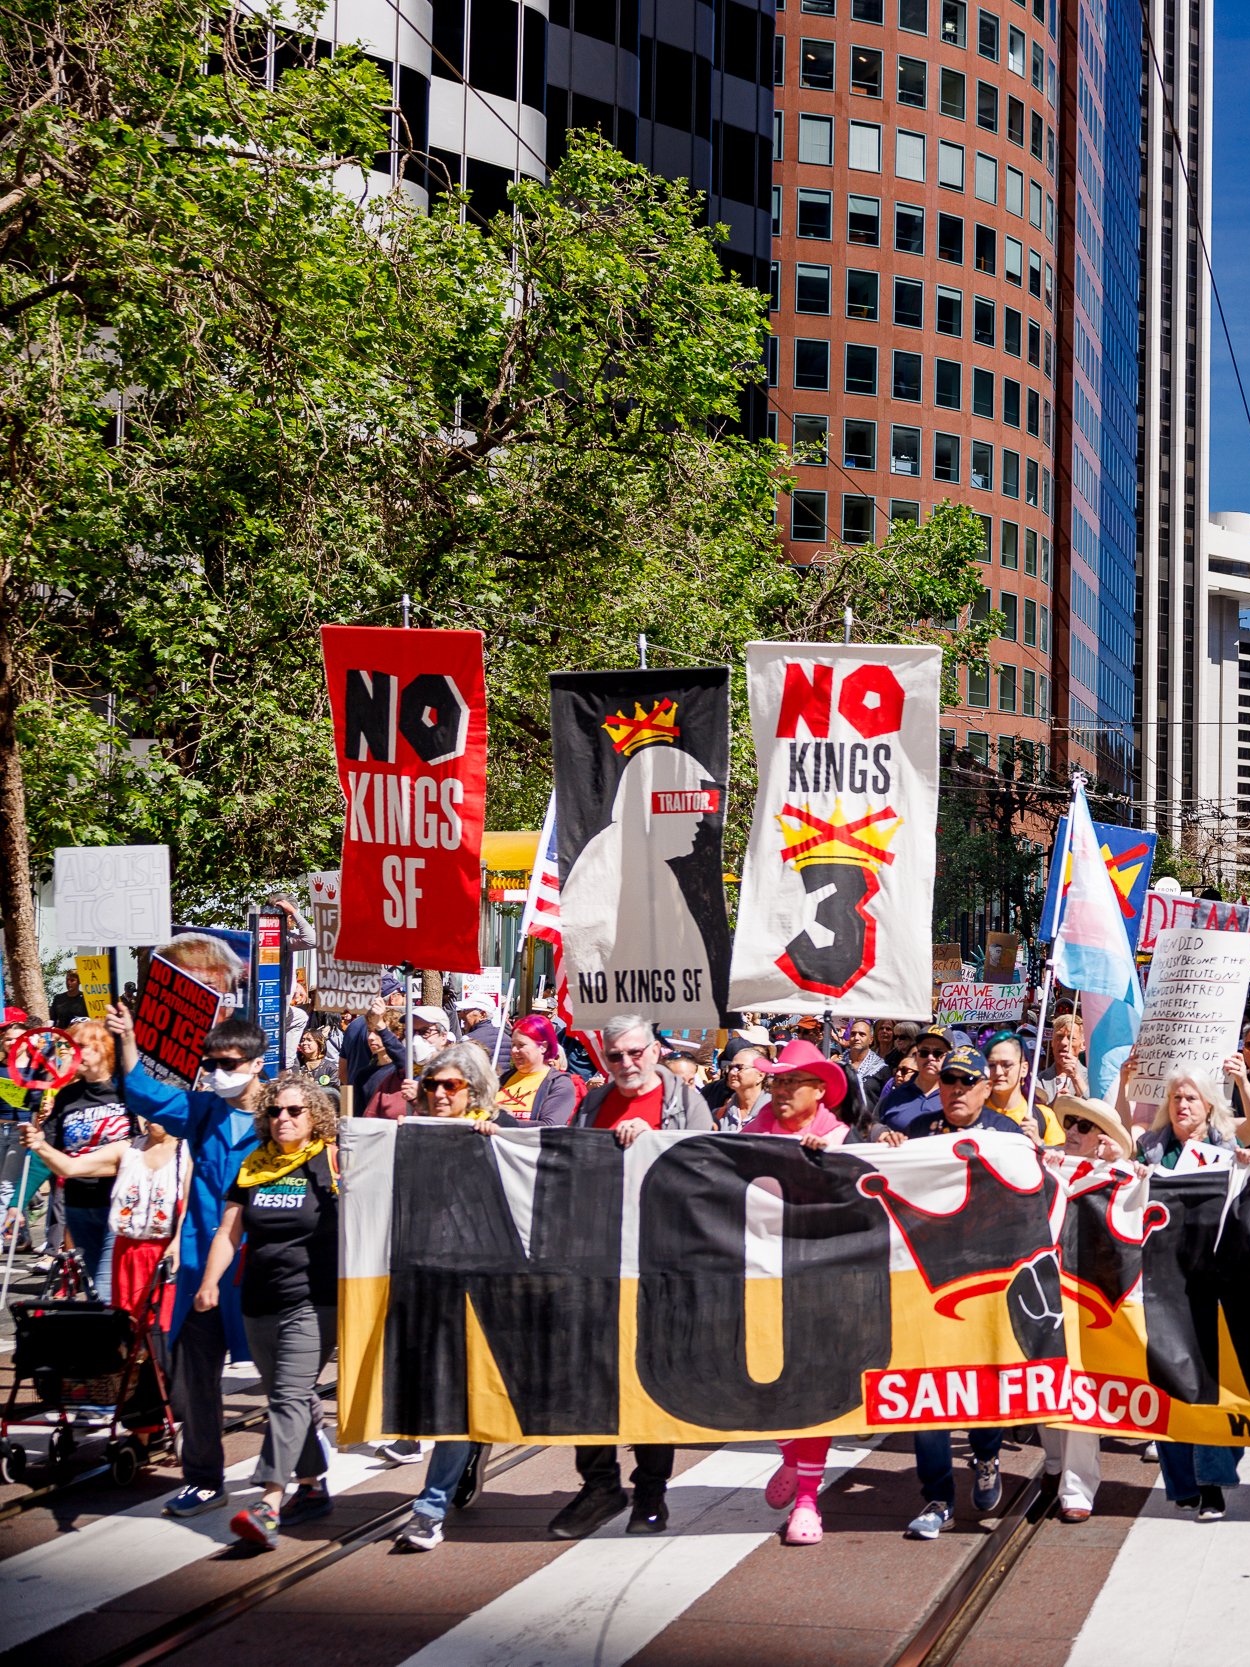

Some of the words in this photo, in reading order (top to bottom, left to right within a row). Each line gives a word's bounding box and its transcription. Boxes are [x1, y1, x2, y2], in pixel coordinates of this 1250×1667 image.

[776, 663, 906, 739] NO
[345, 669, 471, 766] NO
[788, 743, 891, 795] KINGS
[347, 772, 464, 852] KINGS
[56, 852, 168, 895] ABOLISH
[383, 856, 426, 930] SF
[774, 862, 882, 998] 3
[1178, 936, 1204, 952] DID
[81, 959, 102, 971] JOIN
[91, 971, 98, 980] A
[318, 970, 381, 994] WORKERS
[150, 958, 173, 986] NO
[172, 973, 217, 1016] KINGS
[579, 972, 608, 1004] NO
[615, 969, 677, 1003] KINGS
[681, 969, 702, 1002] SF
[941, 984, 971, 998] CAN
[973, 984, 994, 998] WE
[999, 984, 1025, 998] TRY
[1175, 983, 1225, 997] HATRED
[89, 999, 106, 1012] NOT
[145, 979, 160, 999] NO
[159, 987, 212, 1030] PATRIARCHY
[318, 990, 347, 1008] YOU
[938, 996, 1023, 1012] MATRIARCHY
[1173, 998, 1199, 1010] FIRST
[138, 995, 171, 1031] NO
[171, 1014, 208, 1056] ICE
[938, 1010, 977, 1025] NOW??
[1171, 1022, 1228, 1035] SPILLING
[134, 1019, 159, 1051] NO
[159, 1036, 200, 1080] WAR
[1202, 1051, 1220, 1061] OF
[1137, 1060, 1167, 1077] ICE
[1133, 1082, 1152, 1098] NO
[257, 1185, 307, 1195] MOBILIZE
[253, 1193, 307, 1208] RESIST
[382, 1124, 893, 1437] NO
[877, 1370, 980, 1420] SAN
[999, 1363, 1161, 1426] FRASCO
